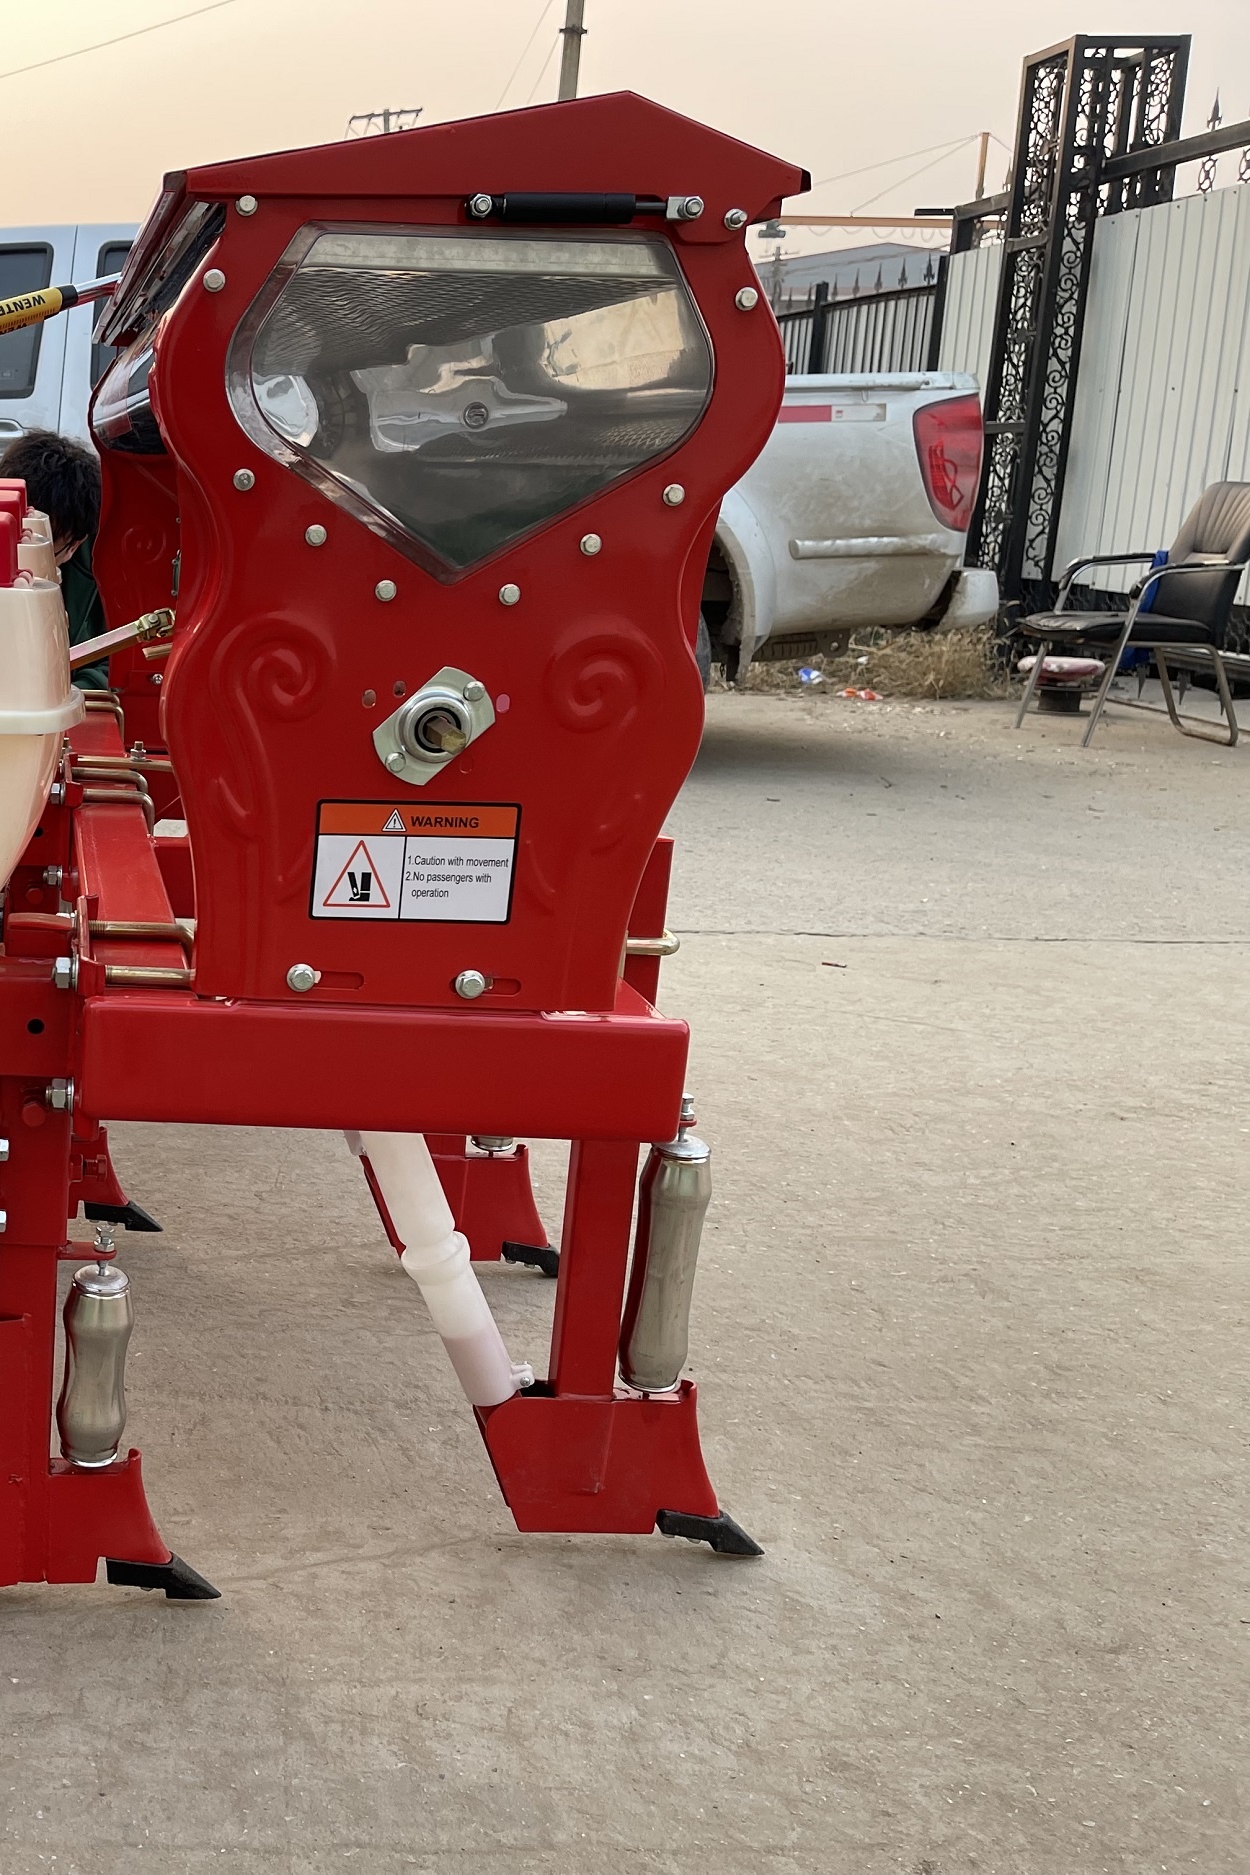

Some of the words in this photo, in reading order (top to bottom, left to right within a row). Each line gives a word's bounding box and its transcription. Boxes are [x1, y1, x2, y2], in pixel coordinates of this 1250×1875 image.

[410, 815, 480, 829] WARNING
[407, 855, 445, 866] 1.Caution
[447, 856, 464, 867] with
[466, 858, 509, 868] movement
[405, 871, 425, 881] 2.No
[426, 874, 474, 885] passengers
[475, 873, 492, 883] with
[411, 888, 449, 899] operation
